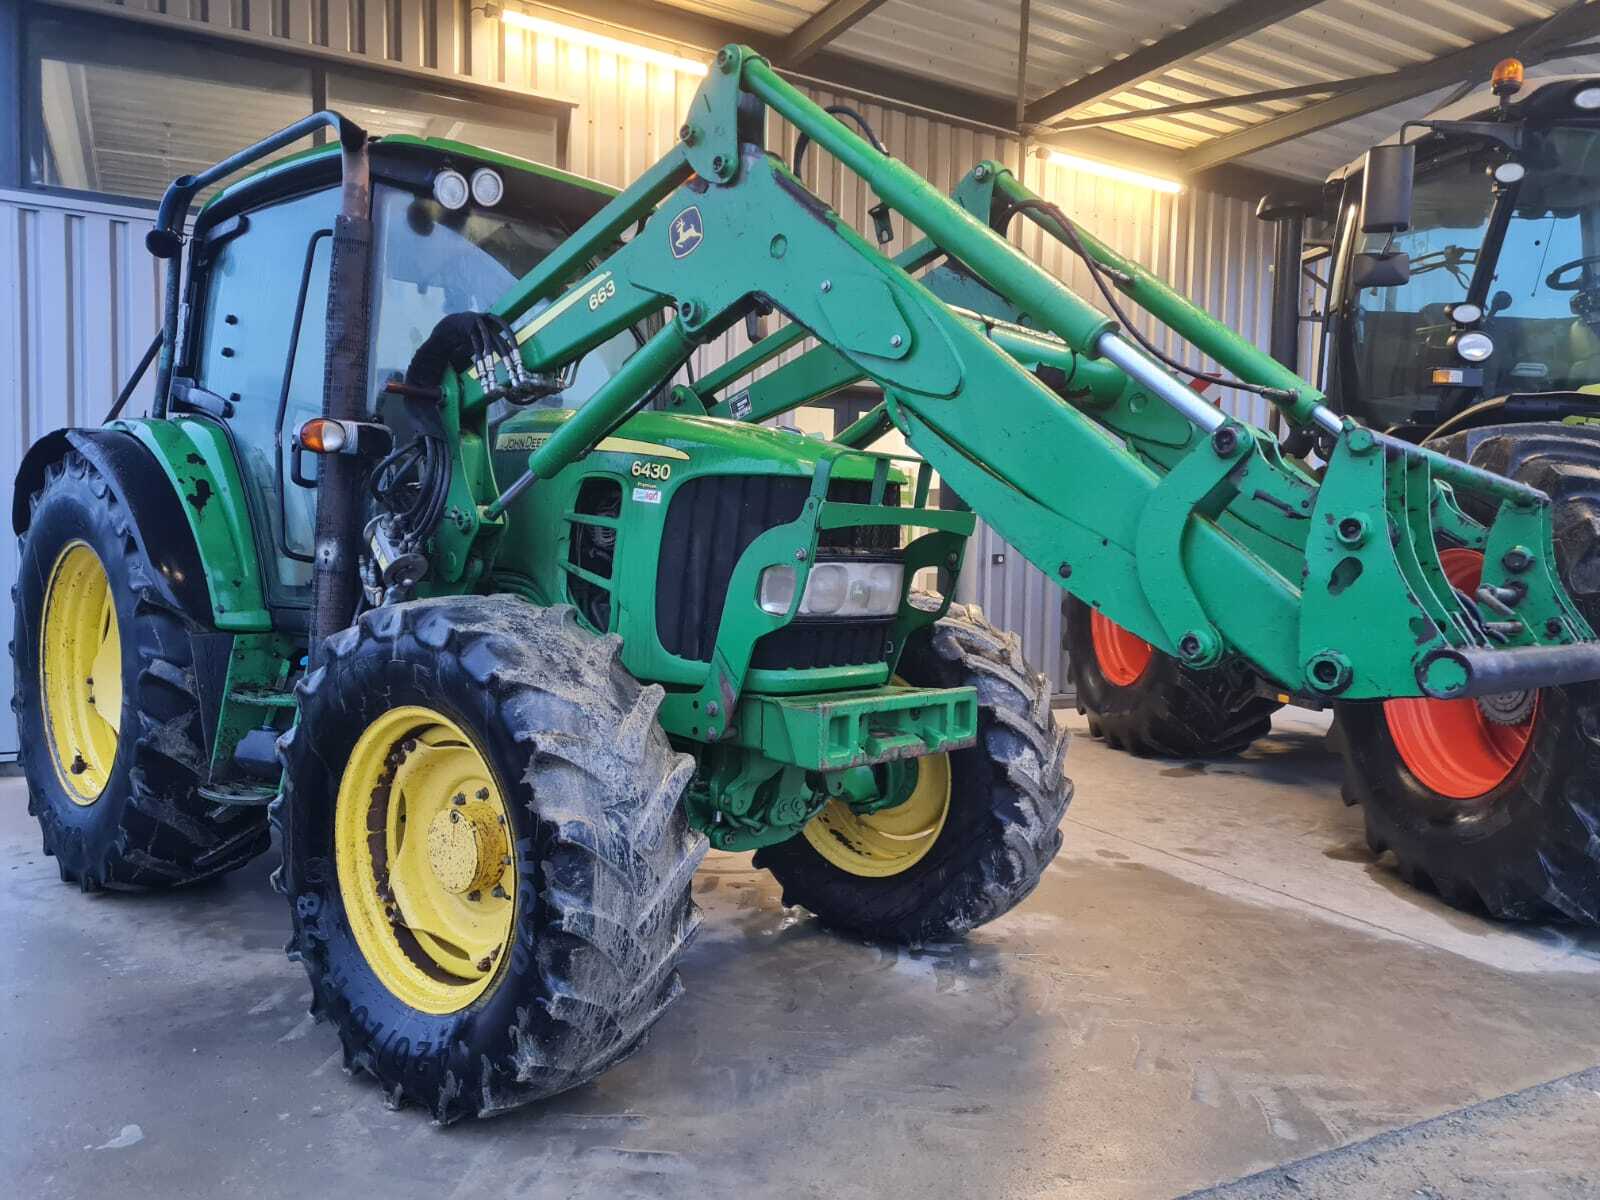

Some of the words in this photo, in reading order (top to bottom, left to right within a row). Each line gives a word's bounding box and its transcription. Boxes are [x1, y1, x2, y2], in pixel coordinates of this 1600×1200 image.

[589, 279, 616, 310] 663
[503, 438, 525, 449] JOHN
[631, 460, 671, 480] 6430
